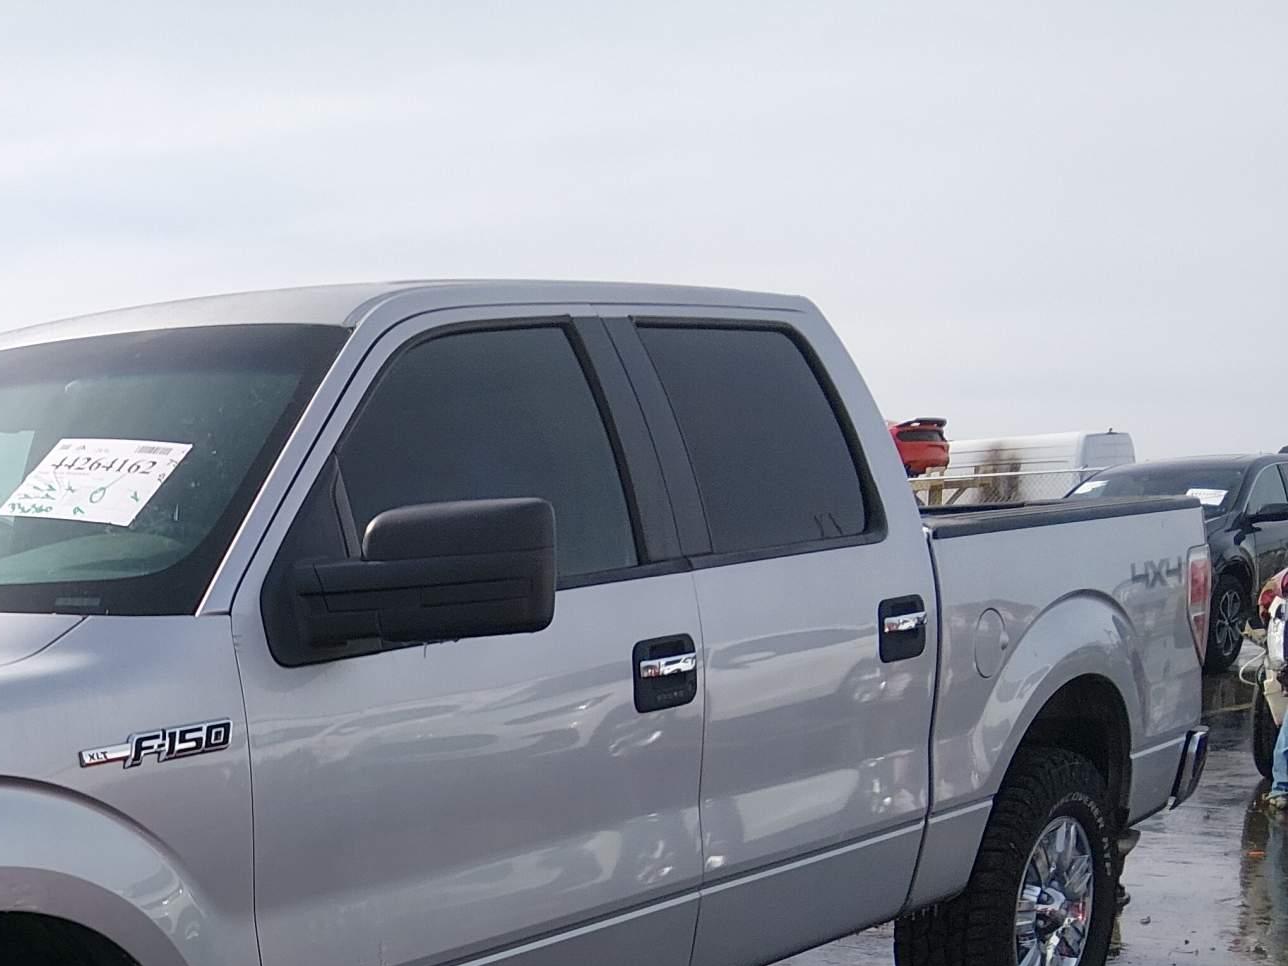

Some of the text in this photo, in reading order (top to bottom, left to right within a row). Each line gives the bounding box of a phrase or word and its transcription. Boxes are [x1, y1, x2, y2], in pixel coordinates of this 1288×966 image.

[51, 456, 157, 475] 44264162
[87, 718, 233, 767] XLT F-150
